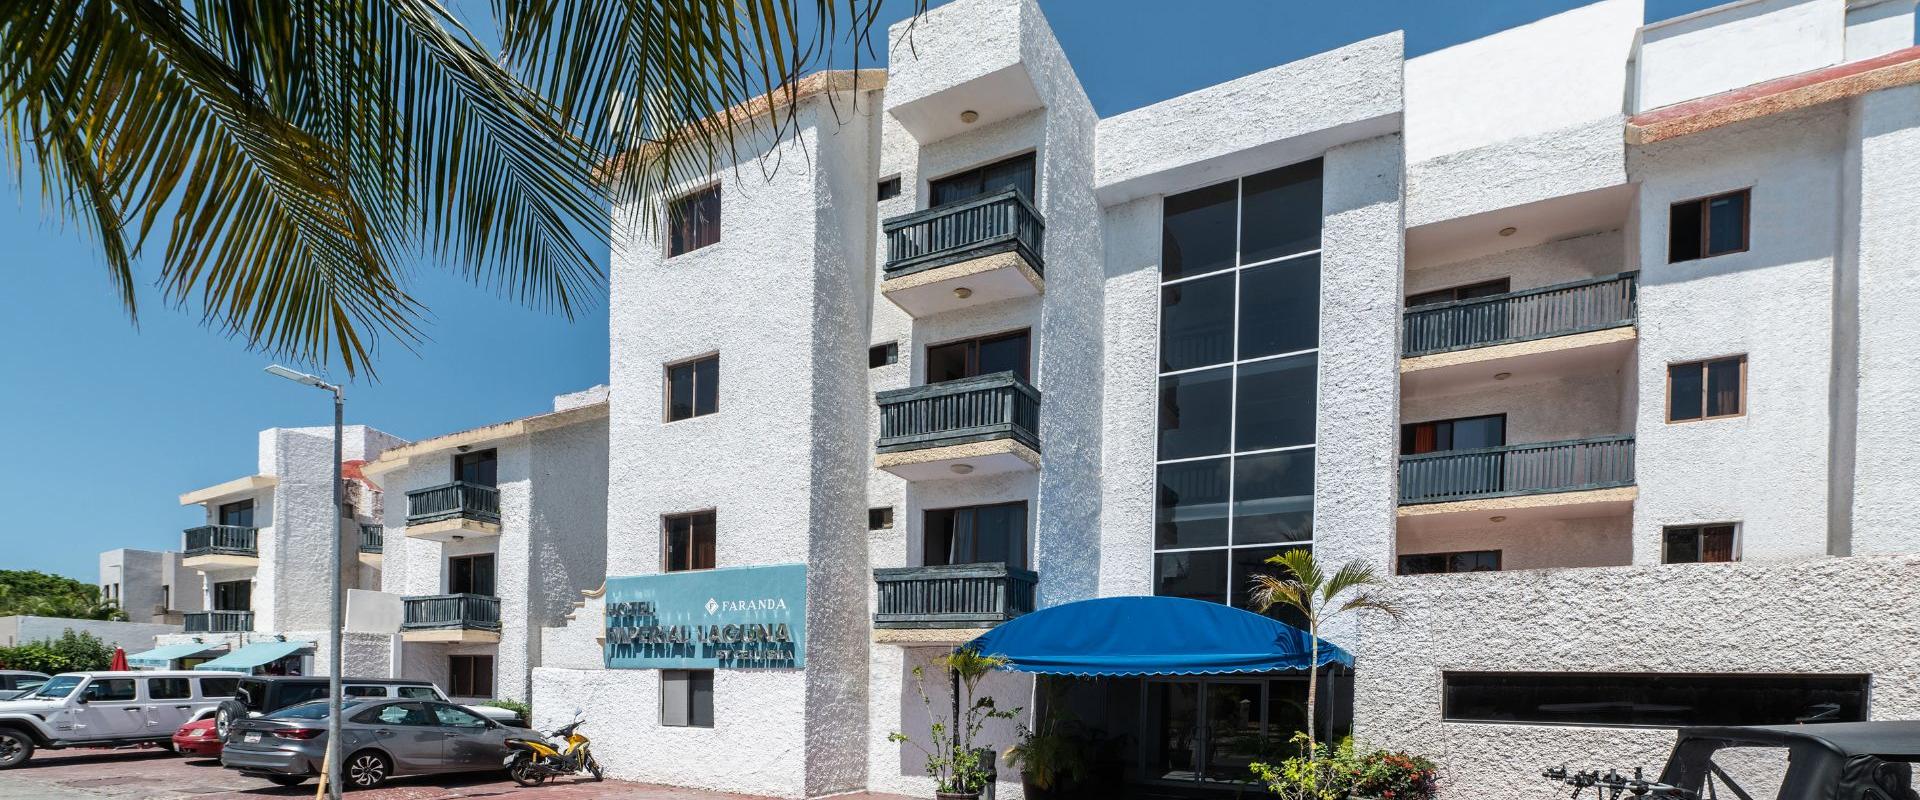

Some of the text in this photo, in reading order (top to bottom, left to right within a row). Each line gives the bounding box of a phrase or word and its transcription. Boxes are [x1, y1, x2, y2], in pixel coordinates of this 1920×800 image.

[606, 601, 656, 616] HOTEL
[722, 598, 787, 612] FARANDA
[606, 623, 792, 644] IMPERIAL LAGUNA
